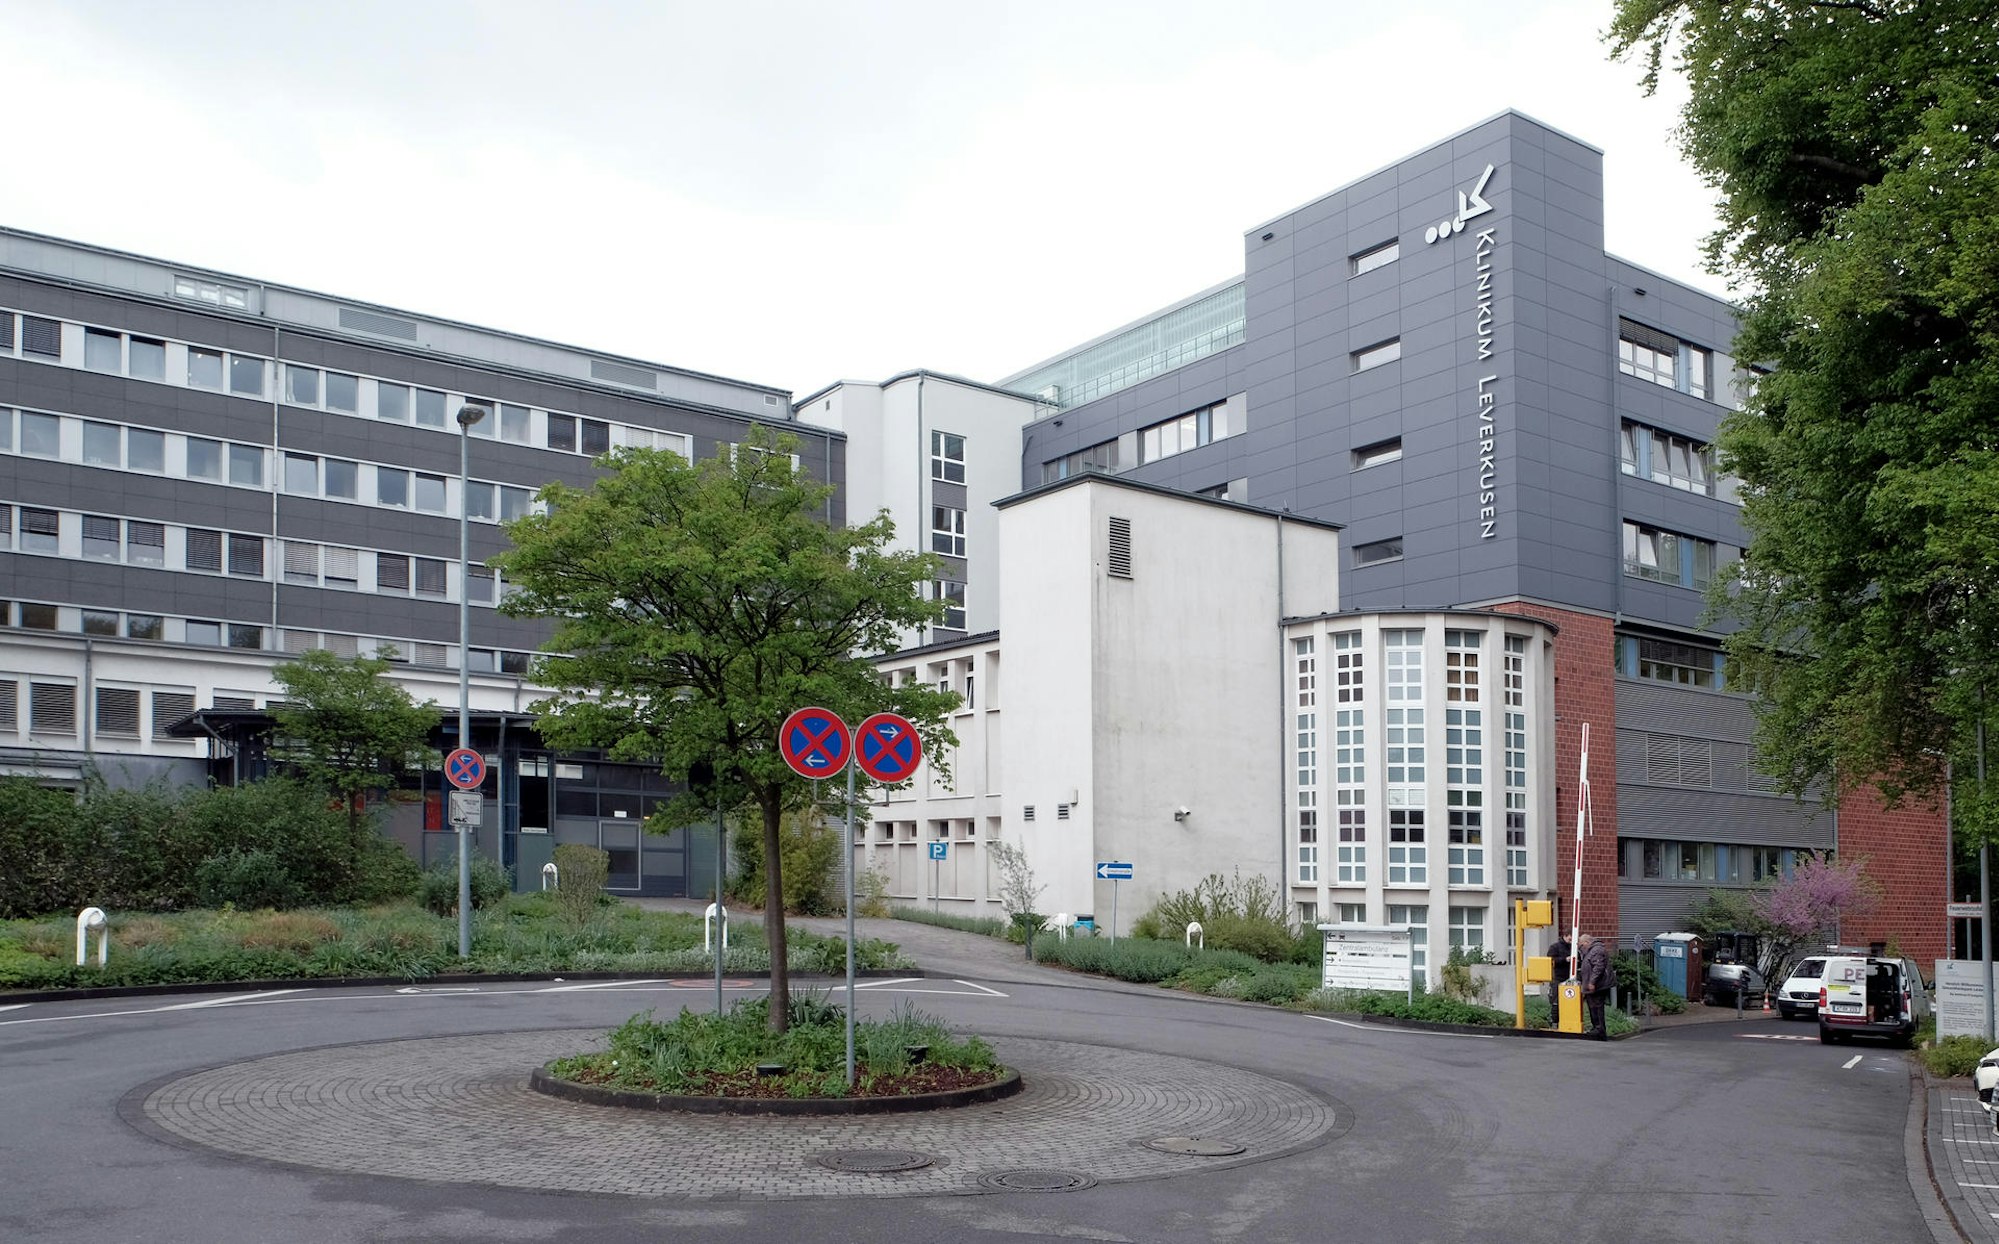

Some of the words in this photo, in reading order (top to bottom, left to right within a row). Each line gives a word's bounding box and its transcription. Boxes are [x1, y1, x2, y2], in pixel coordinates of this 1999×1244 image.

[1475, 227, 1496, 361] KLINIKUM
[1477, 374, 1498, 540] LEVERKUSEN
[933, 845, 943, 858] P
